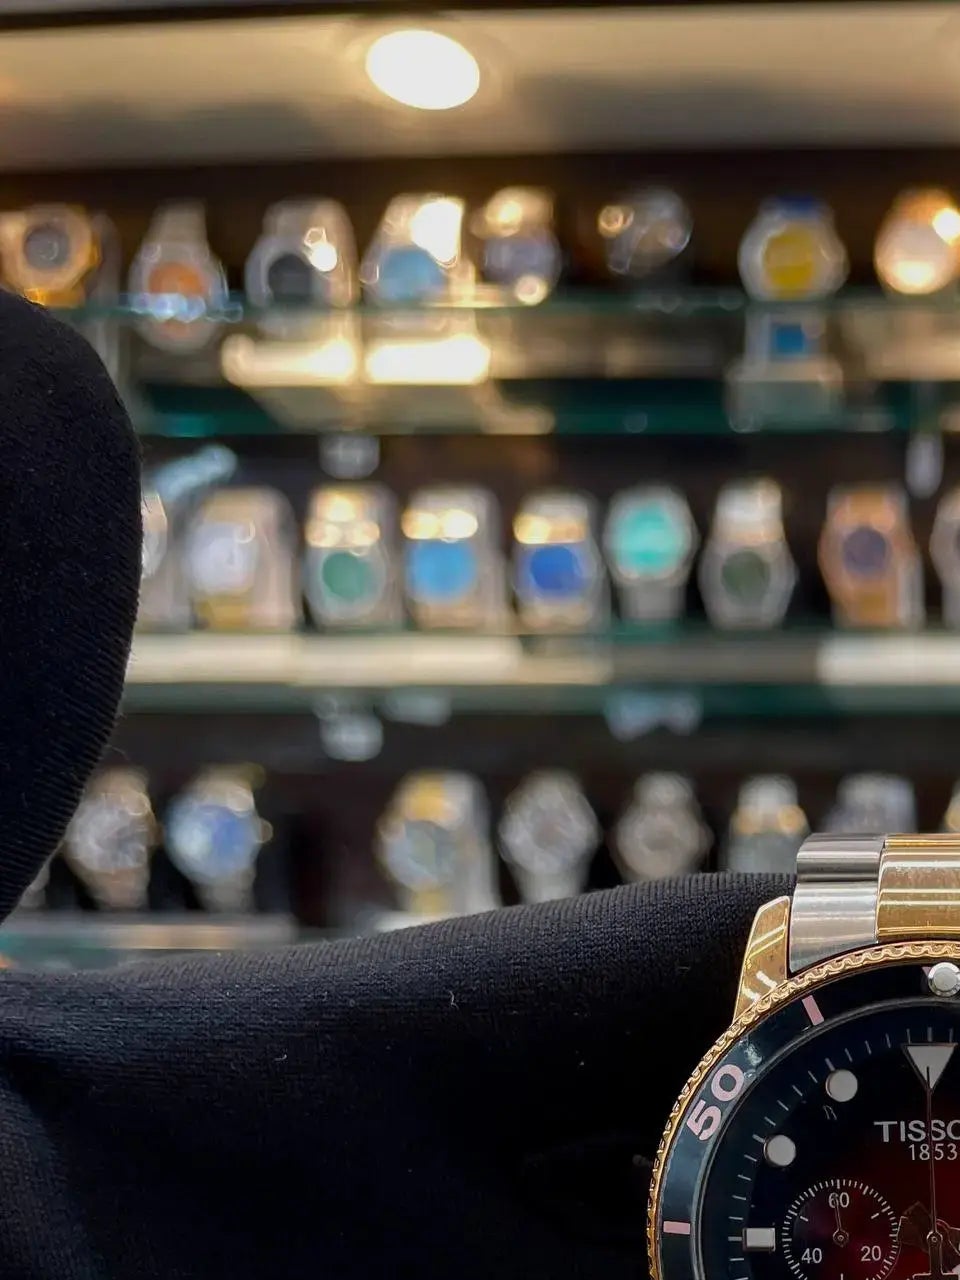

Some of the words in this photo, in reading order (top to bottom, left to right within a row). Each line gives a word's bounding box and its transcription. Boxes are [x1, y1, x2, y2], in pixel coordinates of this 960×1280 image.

[687, 1063, 745, 1142] 50
[908, 1143, 958, 1162] 1853
[829, 1192, 850, 1208] 60
[801, 1247, 822, 1264] 40
[861, 1246, 882, 1262] 20
